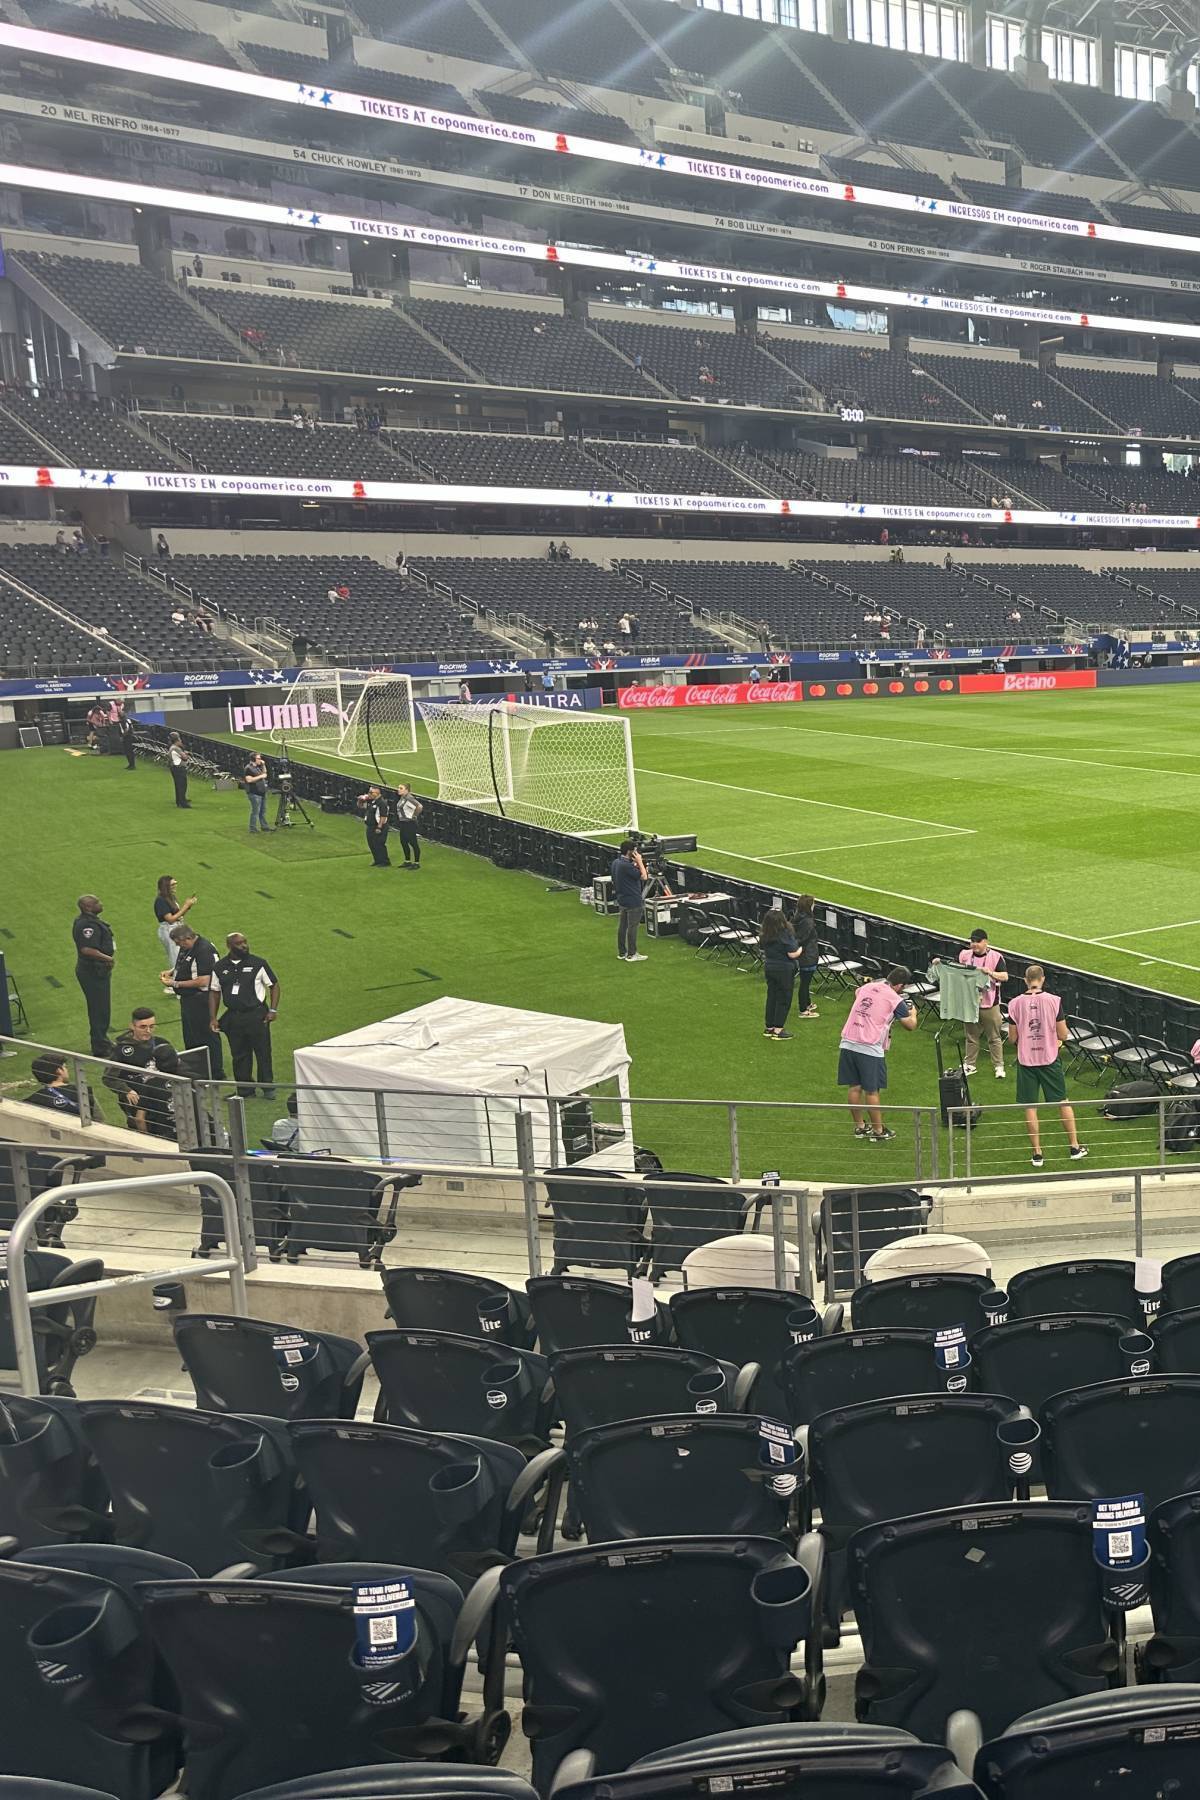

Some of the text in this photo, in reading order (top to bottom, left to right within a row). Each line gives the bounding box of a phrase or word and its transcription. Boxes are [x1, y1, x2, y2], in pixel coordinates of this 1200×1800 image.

[41, 105, 56, 115] 20
[64, 109, 88, 121] MEL
[92, 114, 137, 129] RENFRO
[360, 100, 535, 142] TICKETS AT copaamerica.com
[293, 149, 306, 159] 54
[311, 152, 343, 165] CHUCK
[347, 159, 386, 172] HOWLEY
[688, 161, 828, 192] TICKETS EN copaamerica.com
[533, 189, 550, 199] DON
[554, 193, 595, 206] MEREDITH
[715, 218, 724, 226] 74
[728, 220, 744, 229] BOB
[949, 205, 1079, 231] INGRESSOS EM copaamerica.com
[351, 221, 525, 252] TICKETS AT copaamerica.com
[679, 267, 820, 290] TICKETS EN copaamerica.com
[840, 407, 863, 422] 30:00
[145, 476, 331, 494] TICKETS EN copaamerica.com
[635, 496, 669, 505] TICKETS
[674, 498, 682, 506] AT
[184, 674, 219, 682] ROCKING
[1003, 673, 1056, 691] Betano
[620, 686, 675, 708] Coca-Cola
[685, 684, 738, 706] Coca-Cola
[747, 682, 796, 702] Coca-Cola
[520, 693, 582, 711] ULTRA
[234, 703, 317, 732] PUMA
[1140, 1299, 1160, 1314] Lite
[480, 1317, 500, 1332] Lite
[986, 1312, 1008, 1326] Lite
[628, 1327, 650, 1342] Lite
[790, 1330, 813, 1344] Lite
